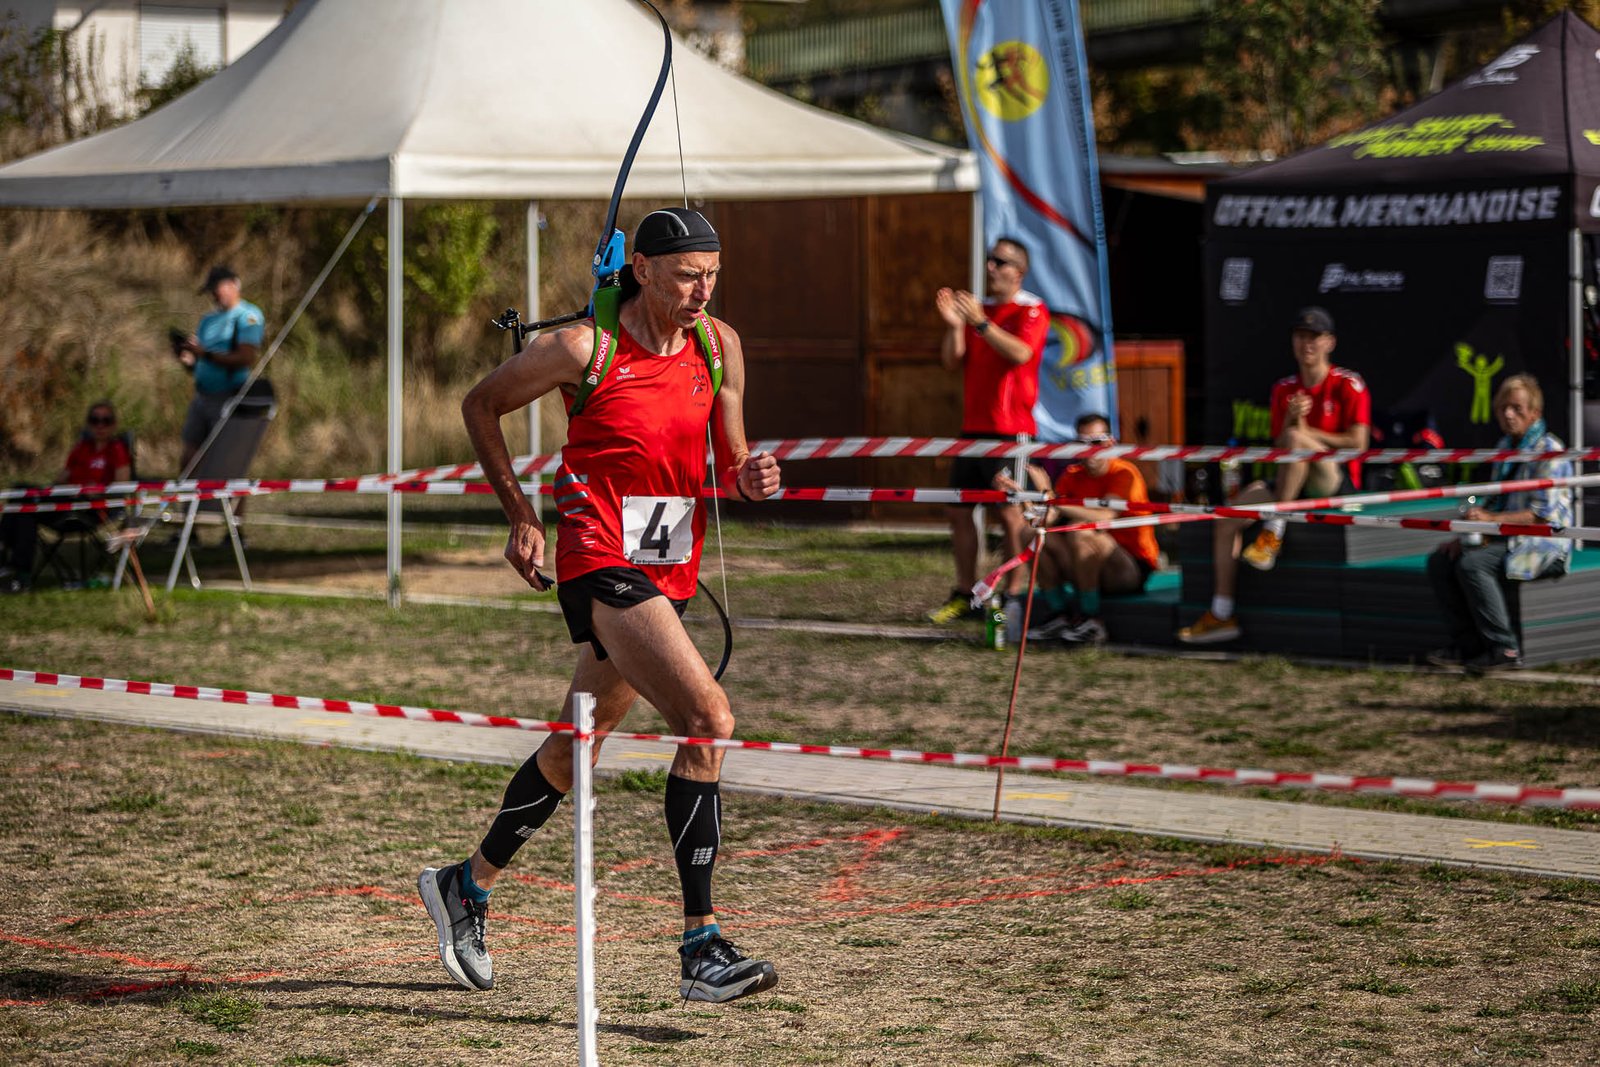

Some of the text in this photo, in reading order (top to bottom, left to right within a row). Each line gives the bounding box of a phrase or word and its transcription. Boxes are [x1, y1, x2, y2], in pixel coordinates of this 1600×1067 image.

[1214, 195, 1338, 228] OFFICIAL
[1339, 186, 1561, 227] MERCHANDISE
[640, 502, 671, 558] 4
